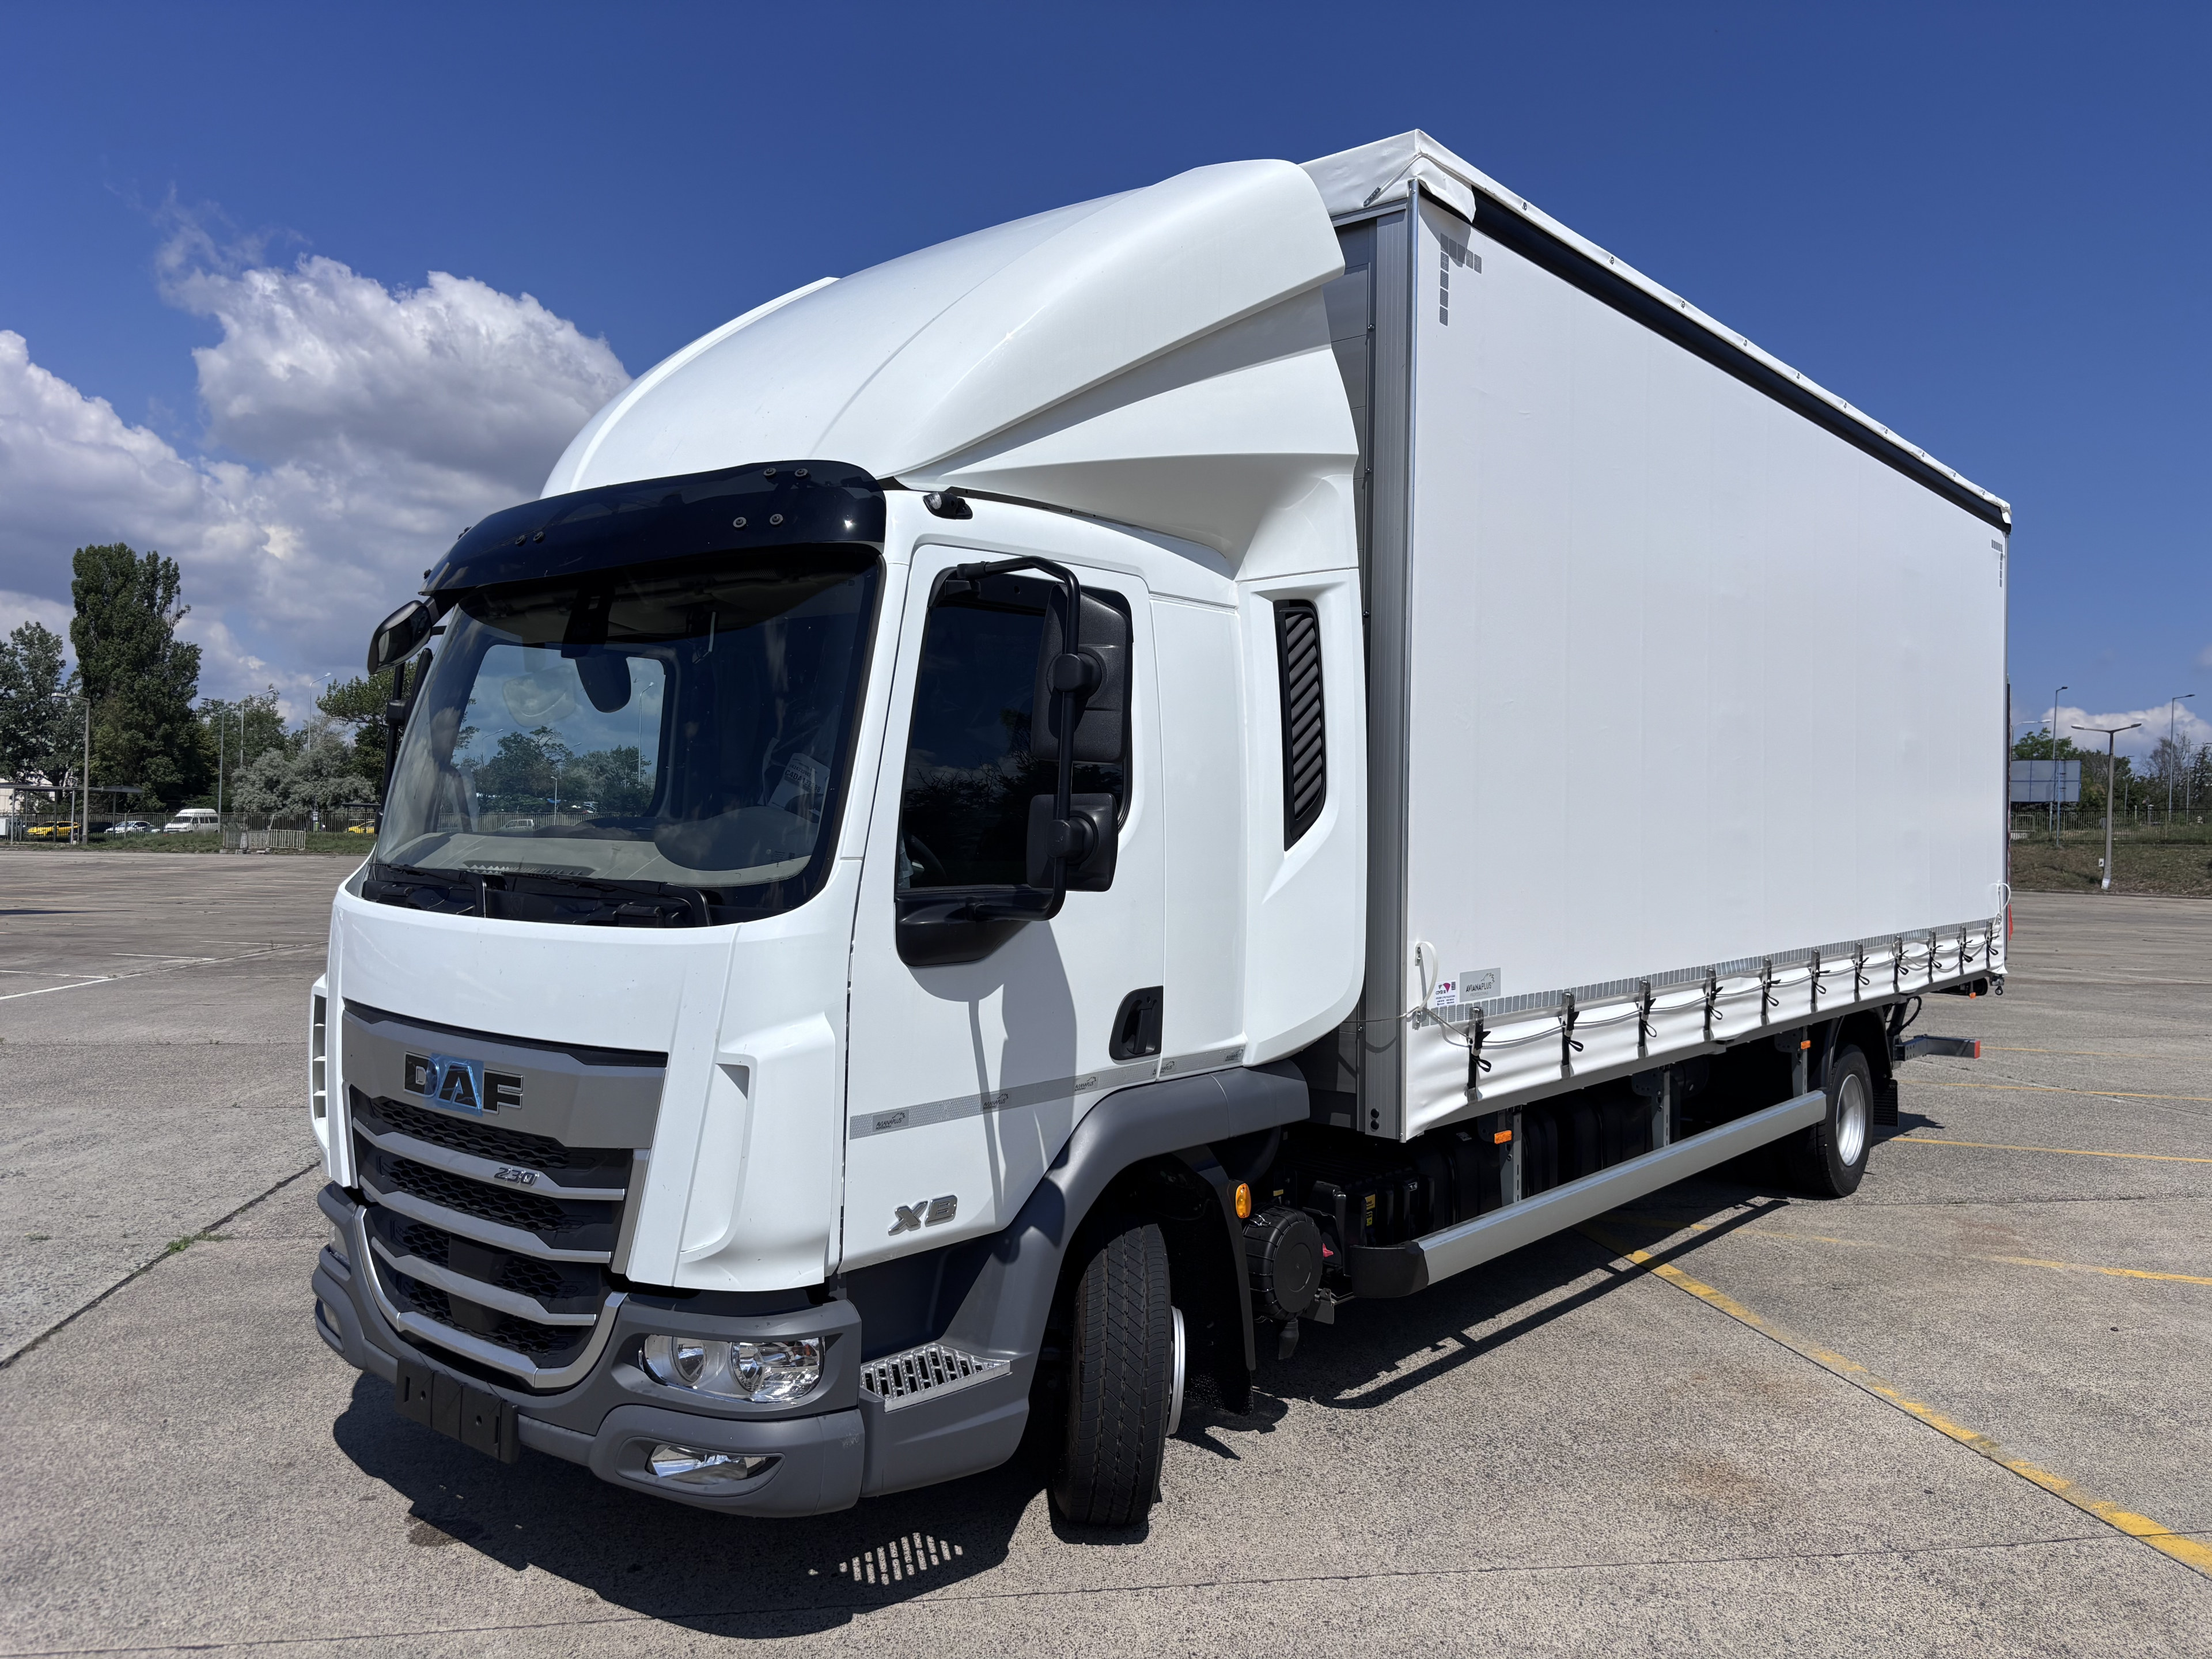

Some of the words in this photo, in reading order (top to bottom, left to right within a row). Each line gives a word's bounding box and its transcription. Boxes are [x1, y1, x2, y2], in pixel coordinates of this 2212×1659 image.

[1465, 982, 1492, 993] AVIANAPLUS
[404, 1051, 524, 1115] DAF
[876, 1118, 902, 1127] AVIANAPLUS
[494, 1167, 539, 1186] 230
[888, 1195, 957, 1236] XB
